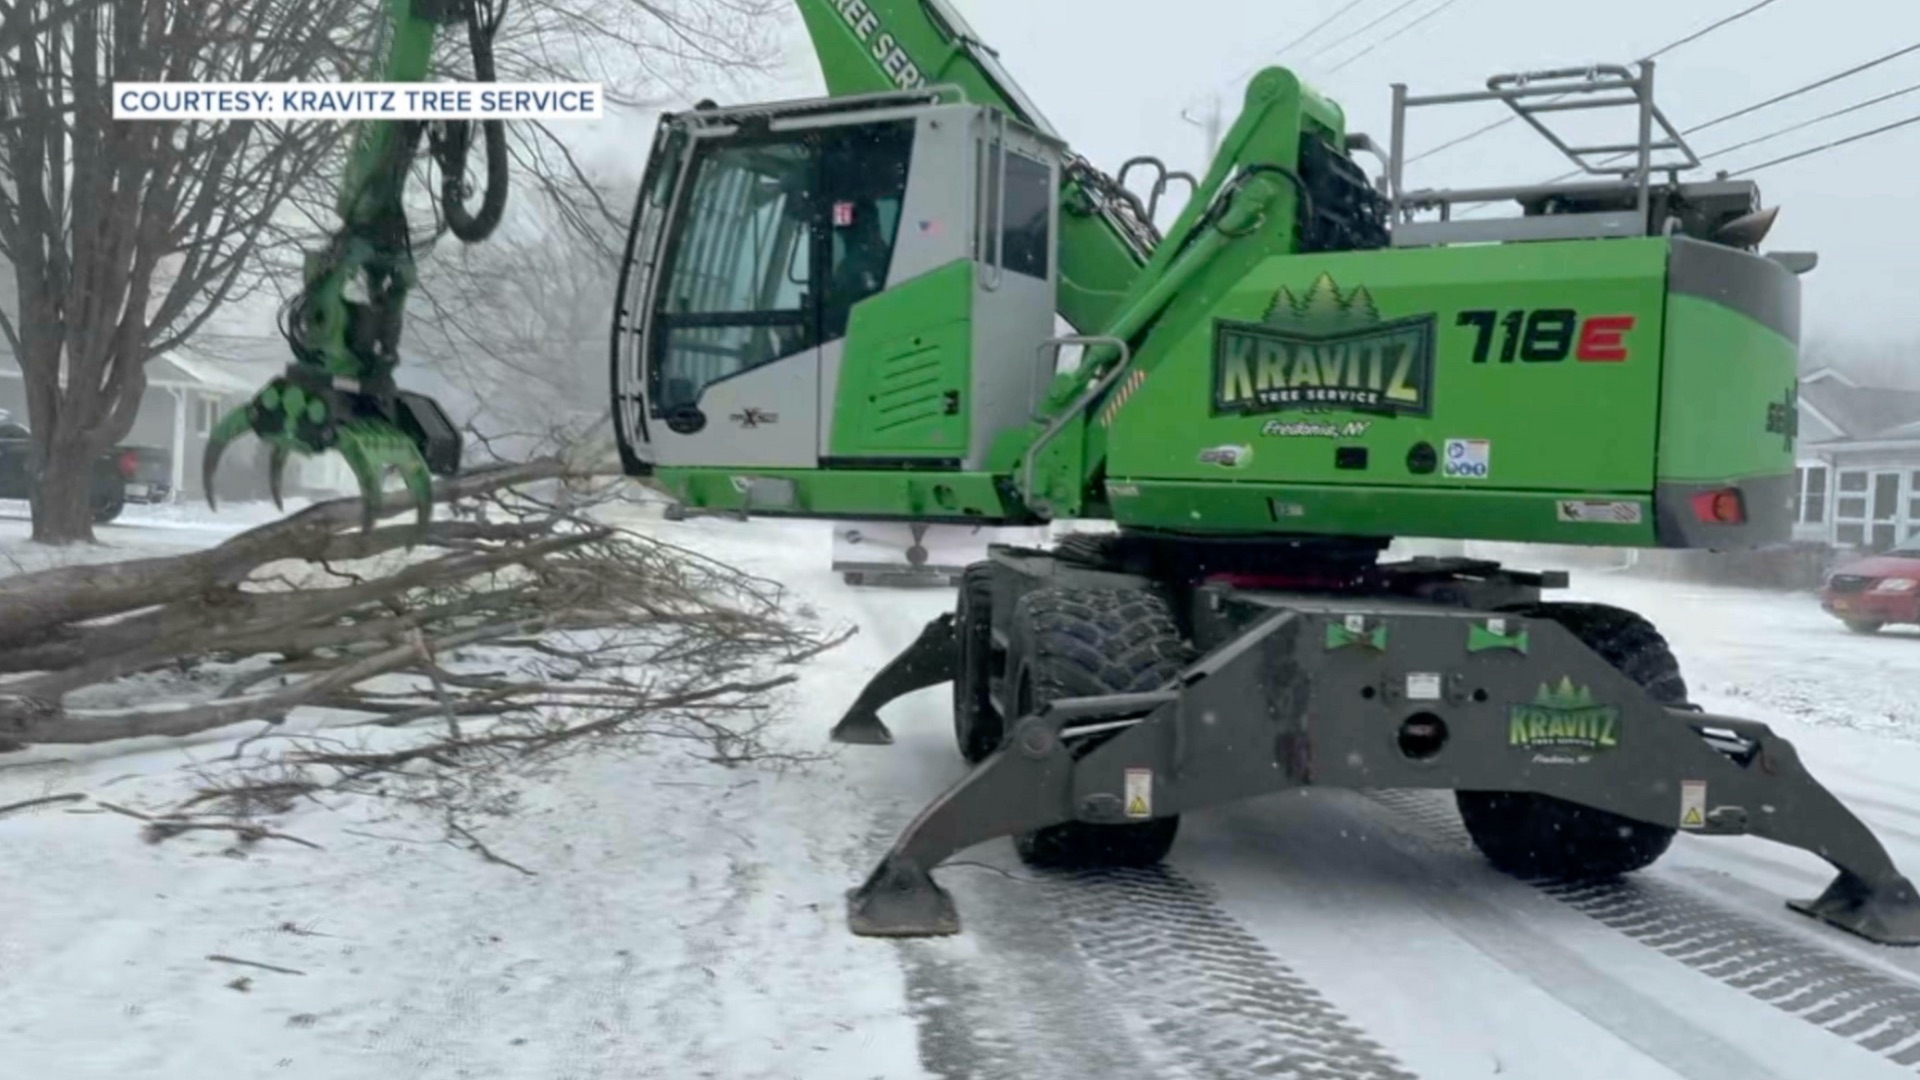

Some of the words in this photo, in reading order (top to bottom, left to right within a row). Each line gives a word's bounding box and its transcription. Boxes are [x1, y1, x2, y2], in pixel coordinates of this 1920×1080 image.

[831, 0, 879, 41] EE
[1456, 309, 1635, 363] 718E
[1222, 329, 1421, 402] KRAVITZ
[1260, 390, 1299, 403] TREE
[1307, 389, 1377, 404] SERVICE
[1510, 705, 1619, 745] KRAVITZ
